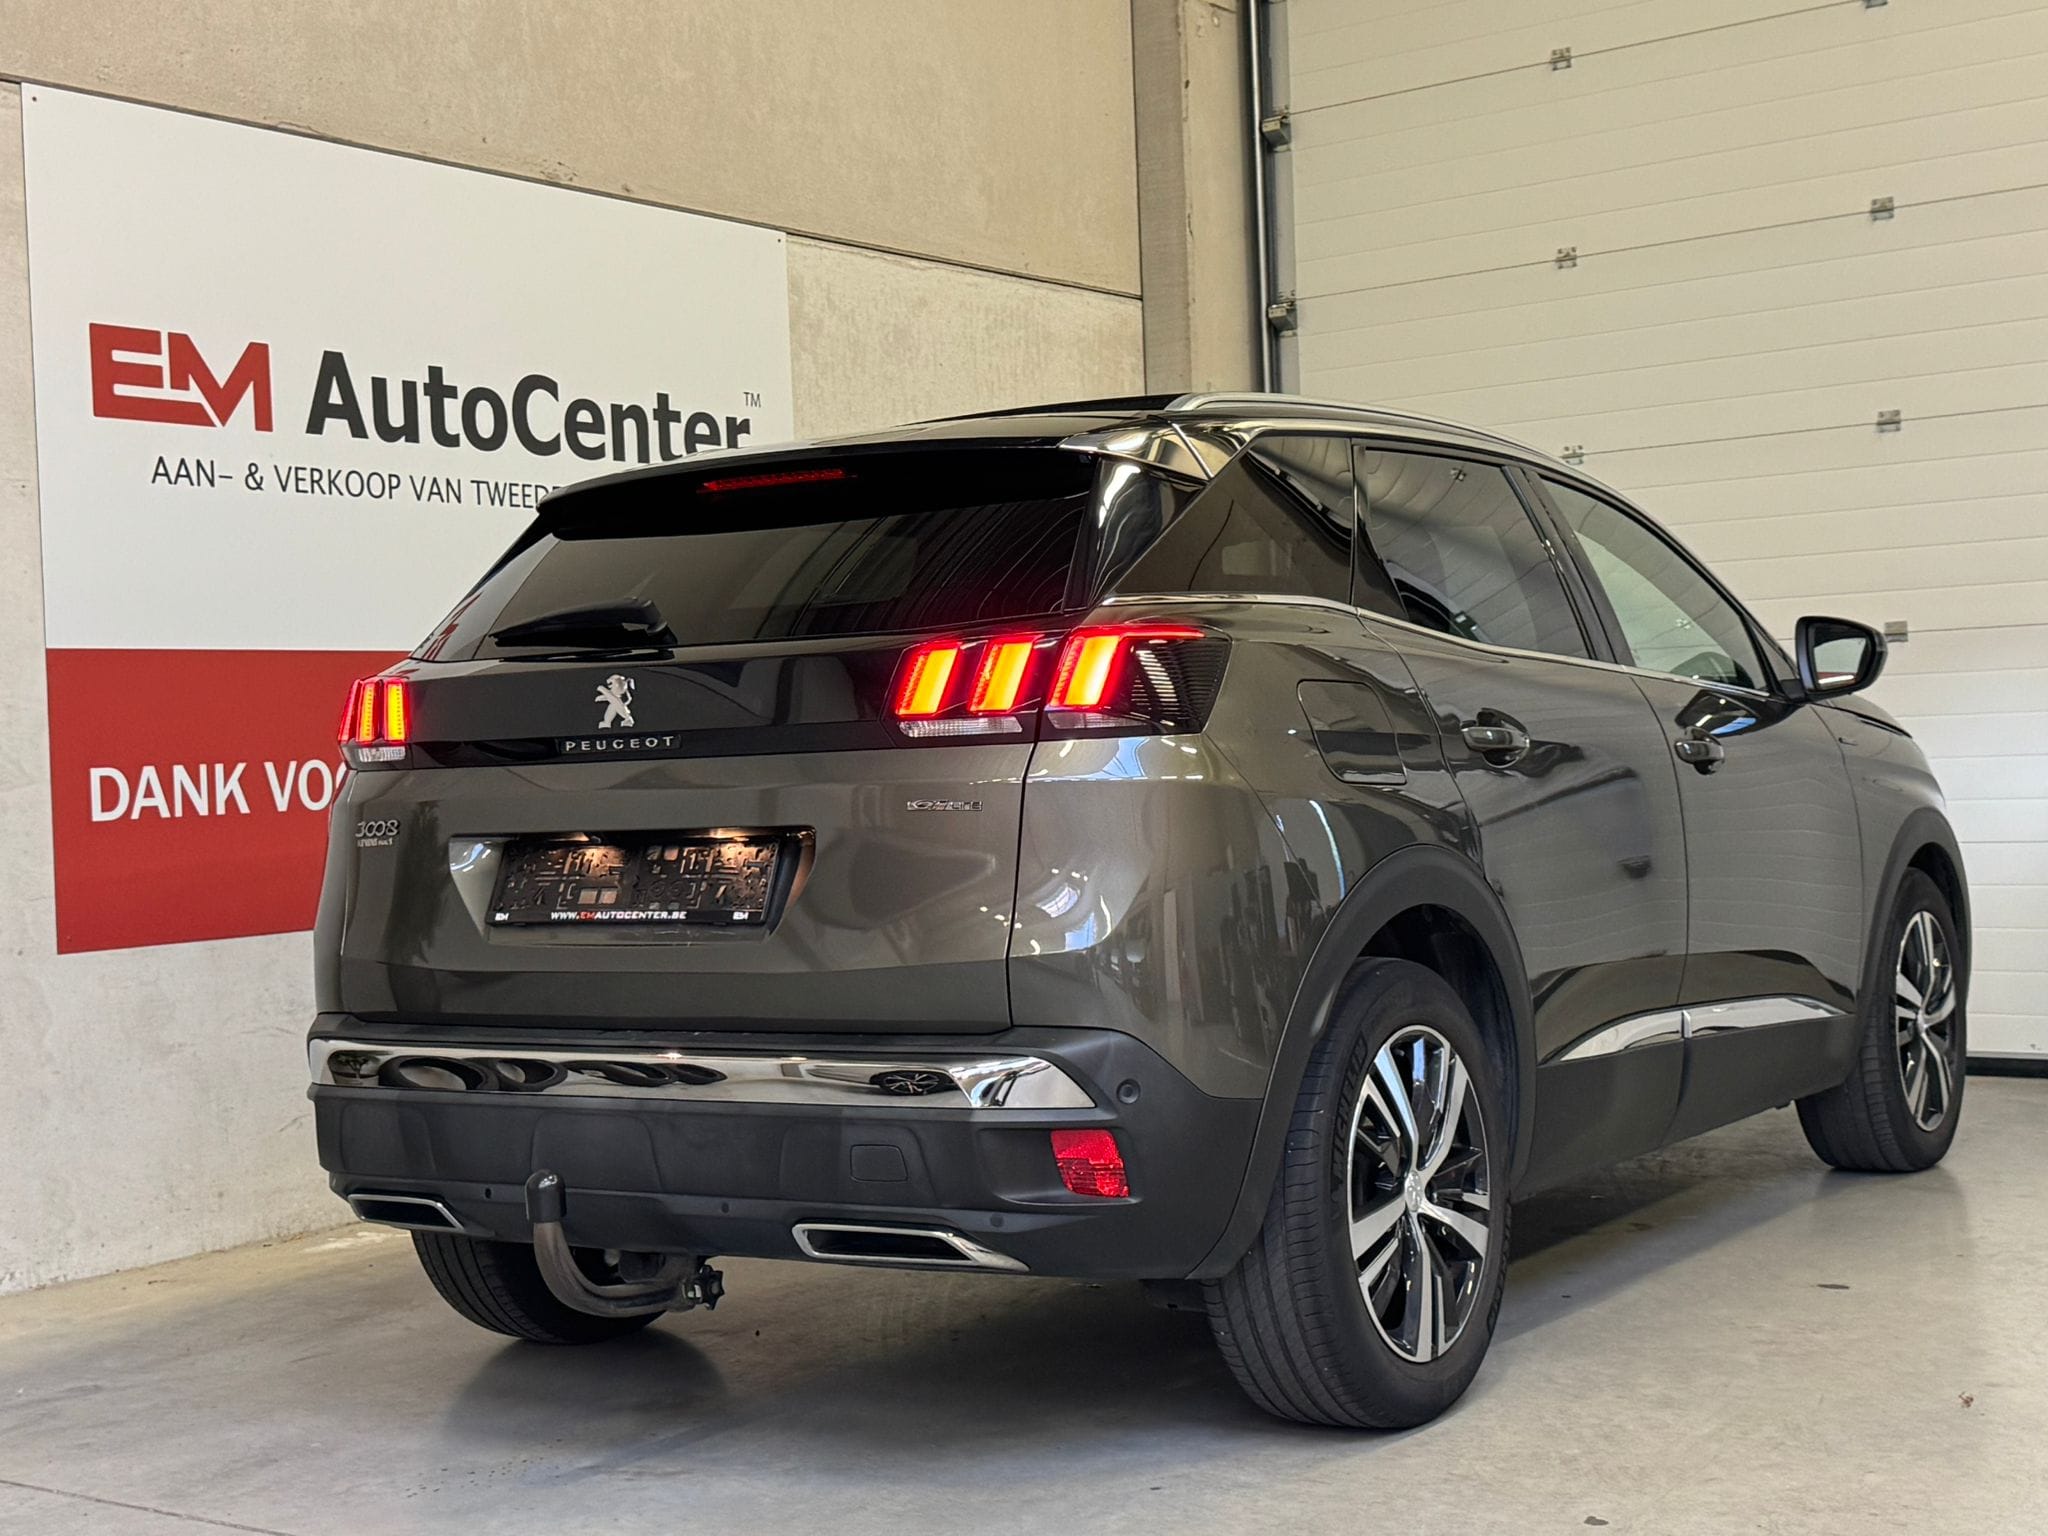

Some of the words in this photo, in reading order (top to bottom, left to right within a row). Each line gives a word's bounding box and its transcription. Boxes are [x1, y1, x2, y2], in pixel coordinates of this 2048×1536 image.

[90, 322, 273, 432] EM
[305, 350, 751, 465] AutoCenter
[244, 462, 264, 491] &
[273, 464, 401, 499] VERKOOP
[409, 474, 462, 504] VAN
[470, 479, 562, 509] TWEED
[565, 735, 674, 752] PEUGEOT
[89, 761, 251, 823] DANK
[355, 819, 398, 838] 3008
[550, 910, 688, 921] WWW.EMAUTOCENTER.BE
